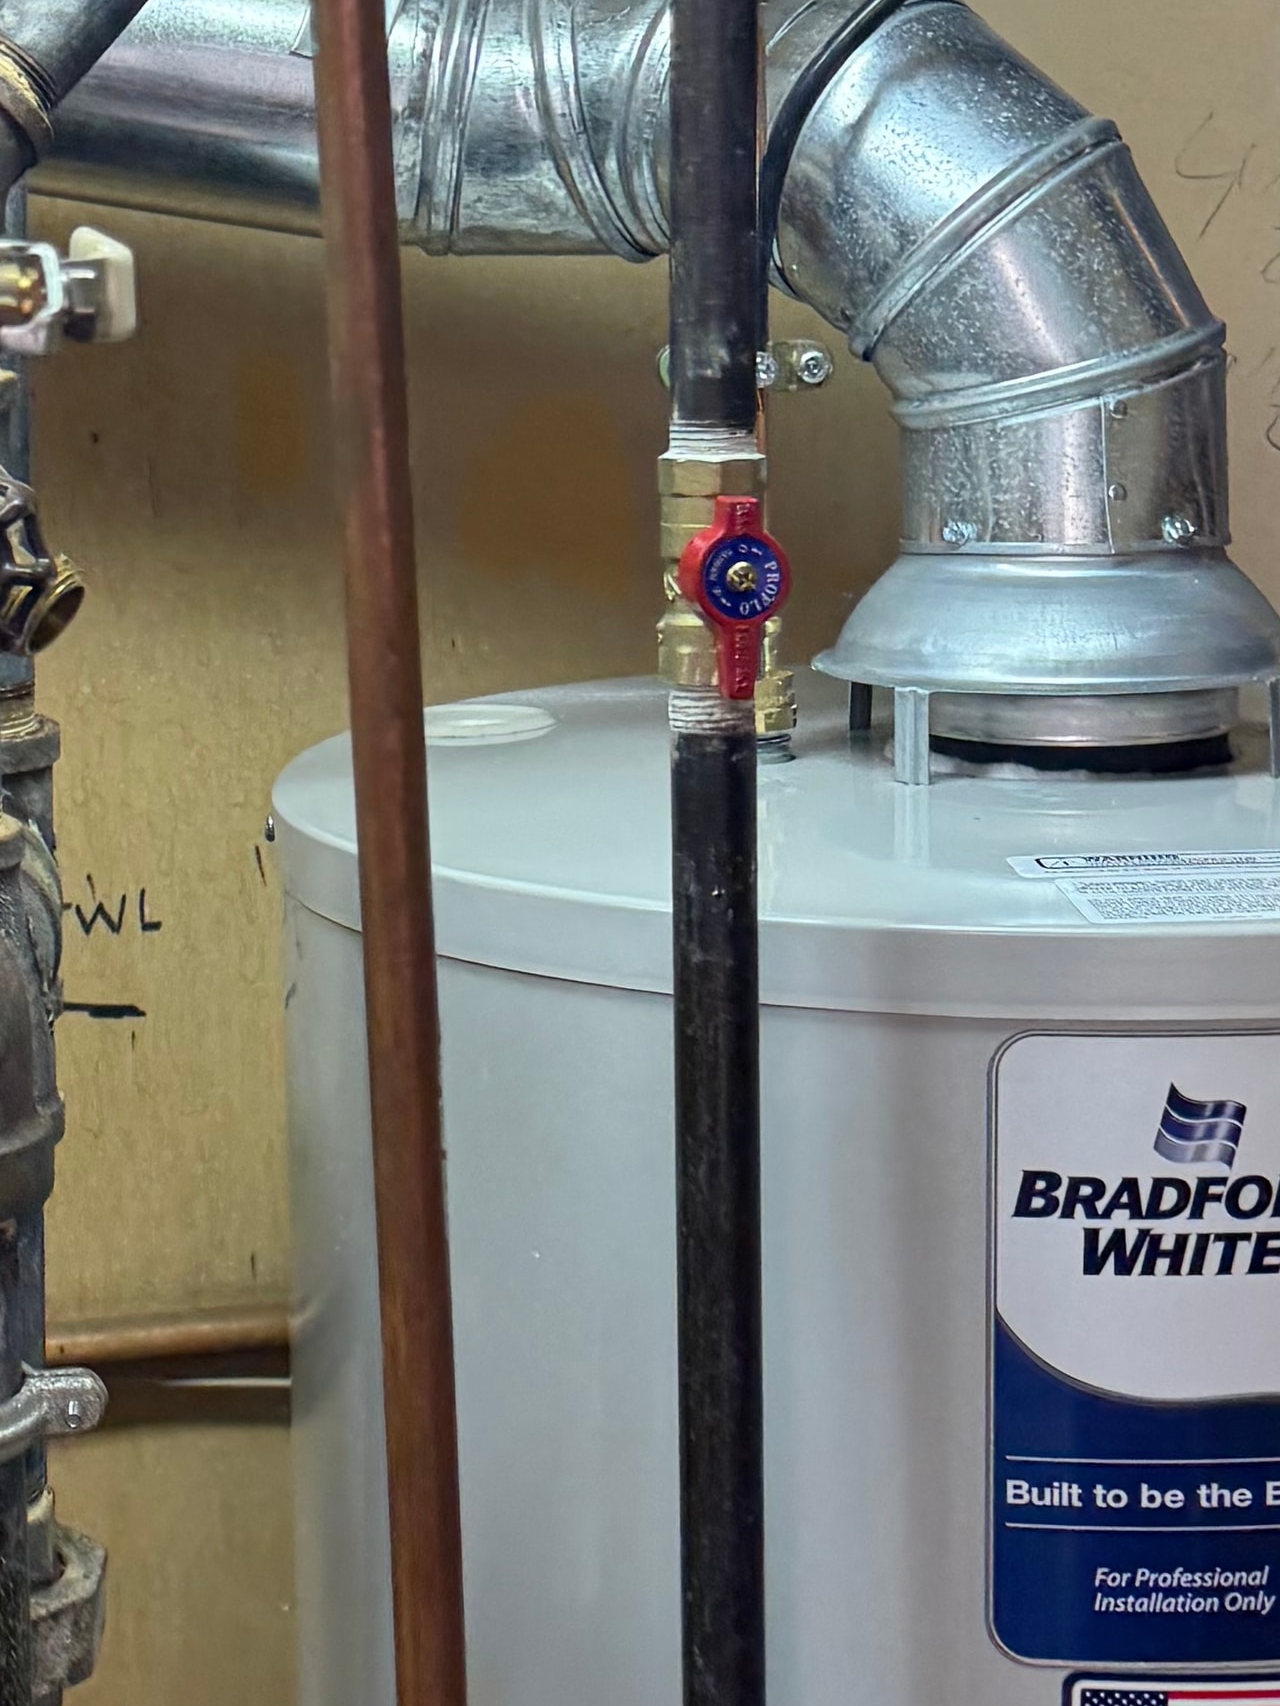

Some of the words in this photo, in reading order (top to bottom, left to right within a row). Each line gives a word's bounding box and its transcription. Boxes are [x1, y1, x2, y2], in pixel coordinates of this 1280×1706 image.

[1005, 1479, 1083, 1507] Built
[1093, 1483, 1128, 1509] to
[1140, 1482, 1185, 1509] be
[1197, 1483, 1254, 1509] the
[1094, 1567, 1131, 1588] For
[1134, 1564, 1270, 1588] Professional
[1093, 1592, 1220, 1613] Installation
[1224, 1592, 1276, 1615] Only
